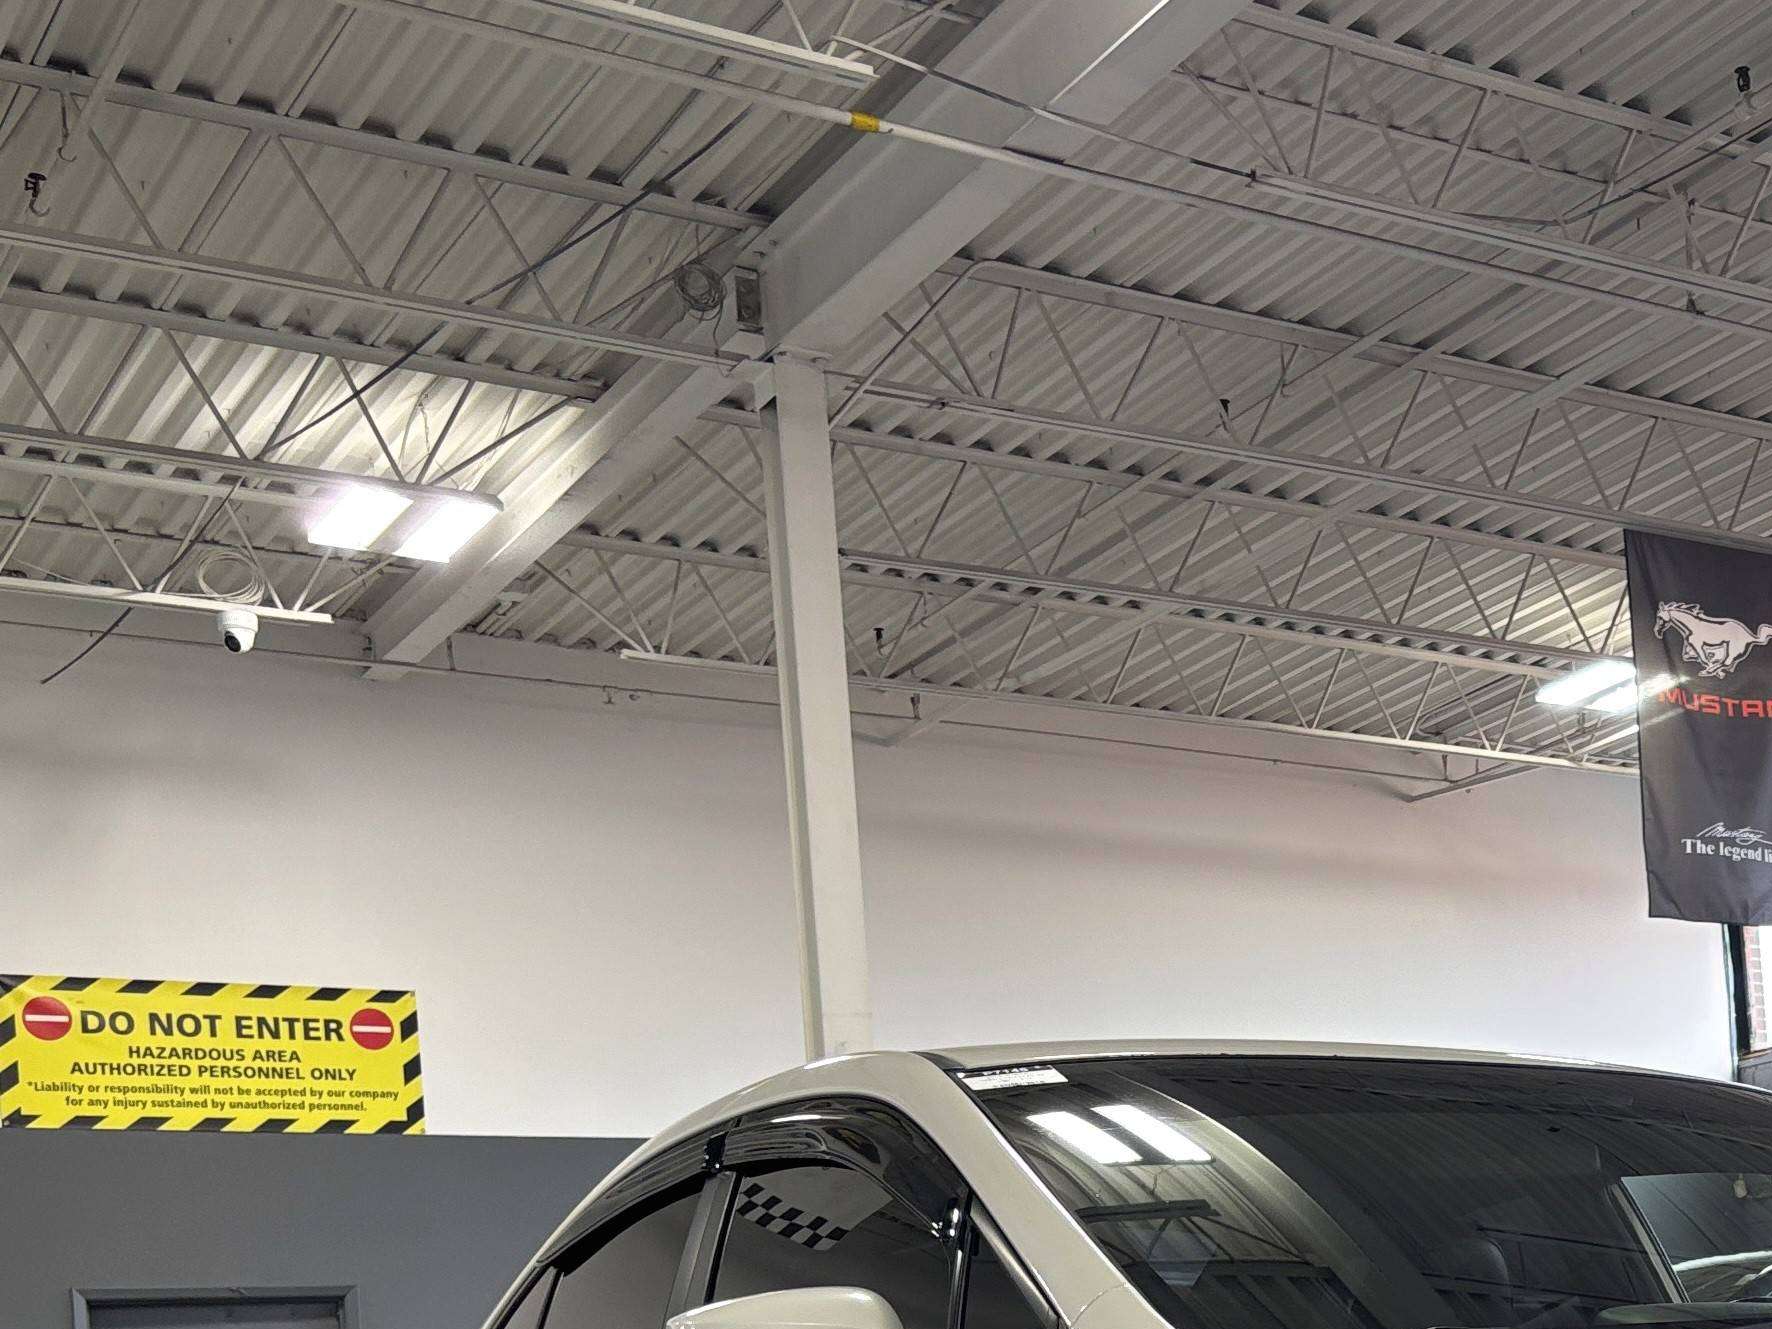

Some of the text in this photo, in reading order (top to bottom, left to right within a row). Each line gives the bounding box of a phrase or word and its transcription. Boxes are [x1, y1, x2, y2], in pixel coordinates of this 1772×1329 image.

[1681, 838, 1715, 855] The
[1719, 841, 1762, 861] legend
[80, 1010, 345, 1042] DO NOT ENTER
[128, 1045, 302, 1063] HAZARDOUS AREA
[70, 1061, 357, 1081] AUTHORIZED PERSONNEL ONLY
[87, 1084, 100, 1093] or
[104, 1083, 186, 1096] responsibility
[189, 1085, 210, 1095] will
[214, 1086, 234, 1096] not
[237, 1085, 250, 1096] be
[255, 1087, 307, 1098] accepted
[309, 1087, 323, 1099] by
[327, 1090, 346, 1098] our
[349, 1090, 399, 1100] company
[65, 1095, 84, 1106] for
[87, 1098, 110, 1109] any
[113, 1097, 147, 1109] injury
[151, 1098, 208, 1108] sustained
[211, 1100, 225, 1111] by
[229, 1100, 305, 1111] unauthorized
